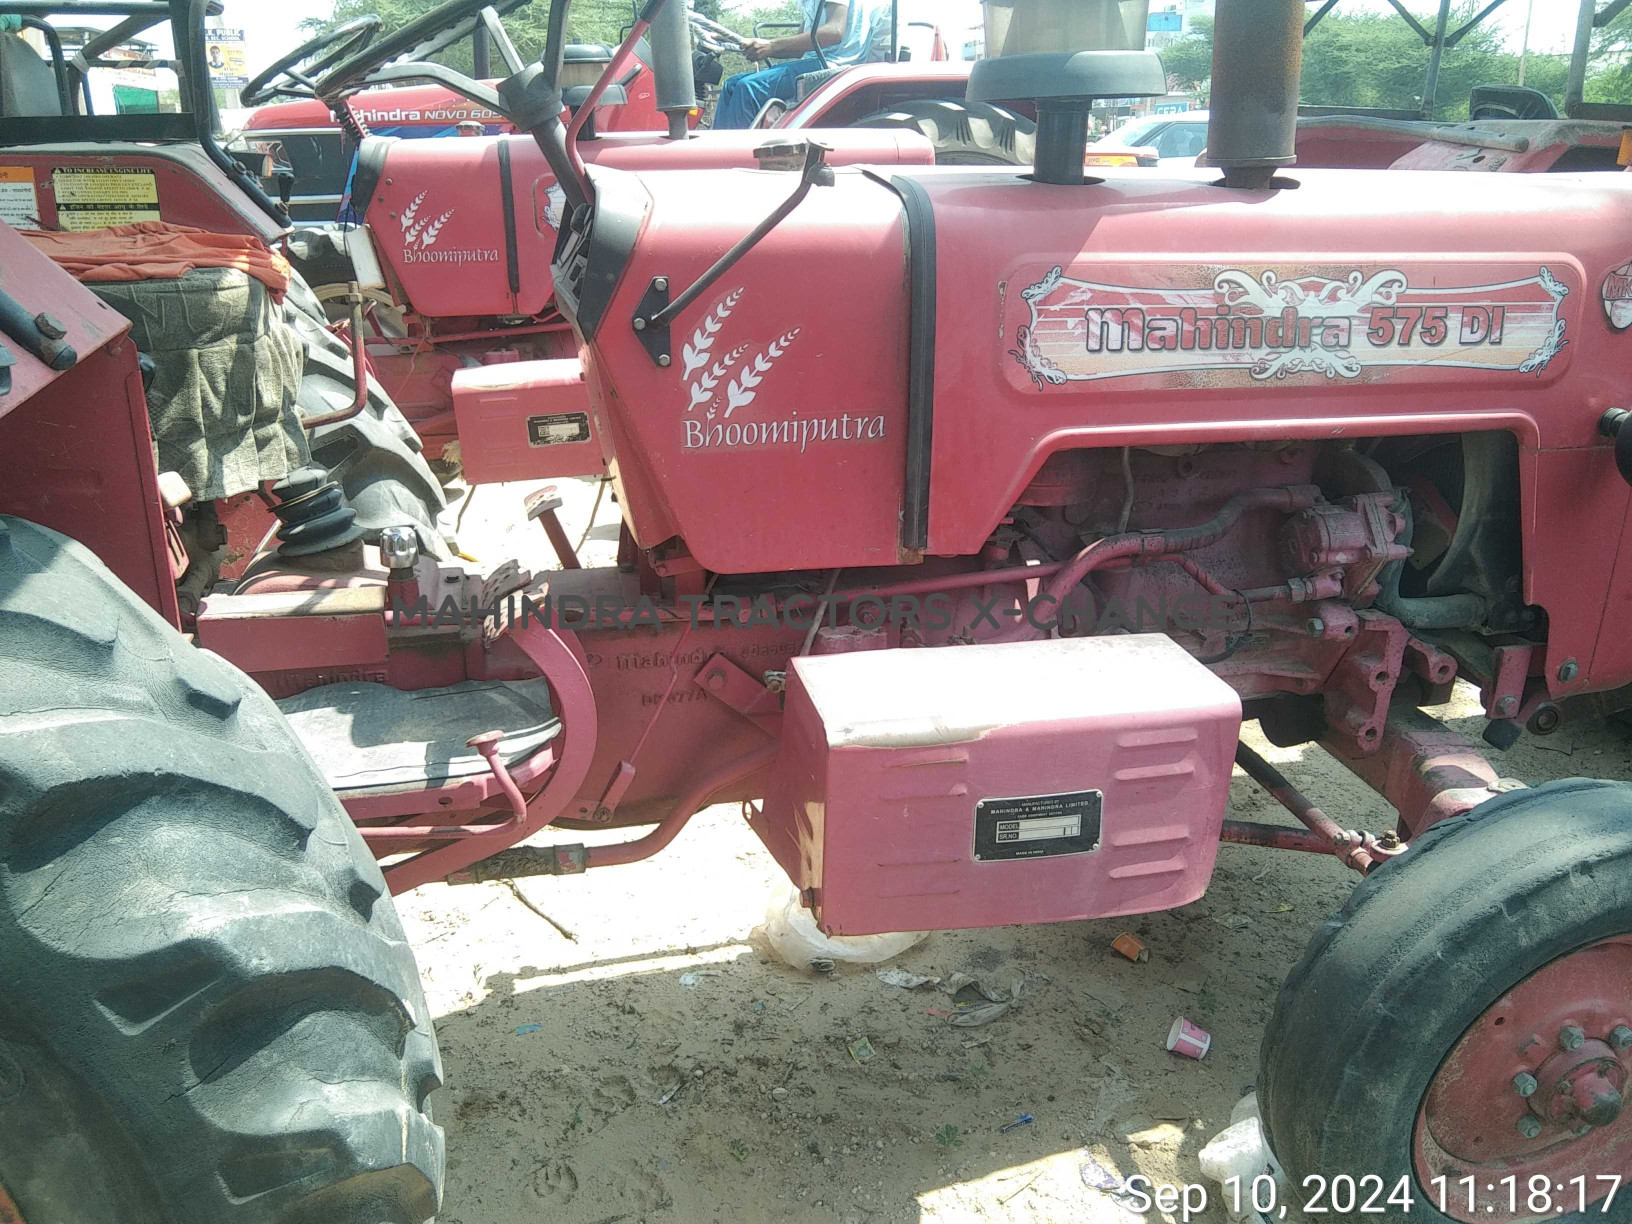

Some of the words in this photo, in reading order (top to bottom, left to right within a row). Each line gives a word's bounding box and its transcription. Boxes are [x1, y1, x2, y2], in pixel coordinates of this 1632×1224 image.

[216, 28, 241, 36] PUBLIC
[330, 108, 420, 122] hindra
[424, 109, 467, 119] NOVO
[402, 246, 499, 268] Bhoomiputra
[1085, 306, 1352, 352] Mahindra
[1366, 306, 1448, 346] 575
[1458, 306, 1506, 345] DI
[683, 410, 886, 454] Bhoomiputra
[990, 807, 1023, 815] MAHINDRA
[999, 823, 1019, 831] MODEL
